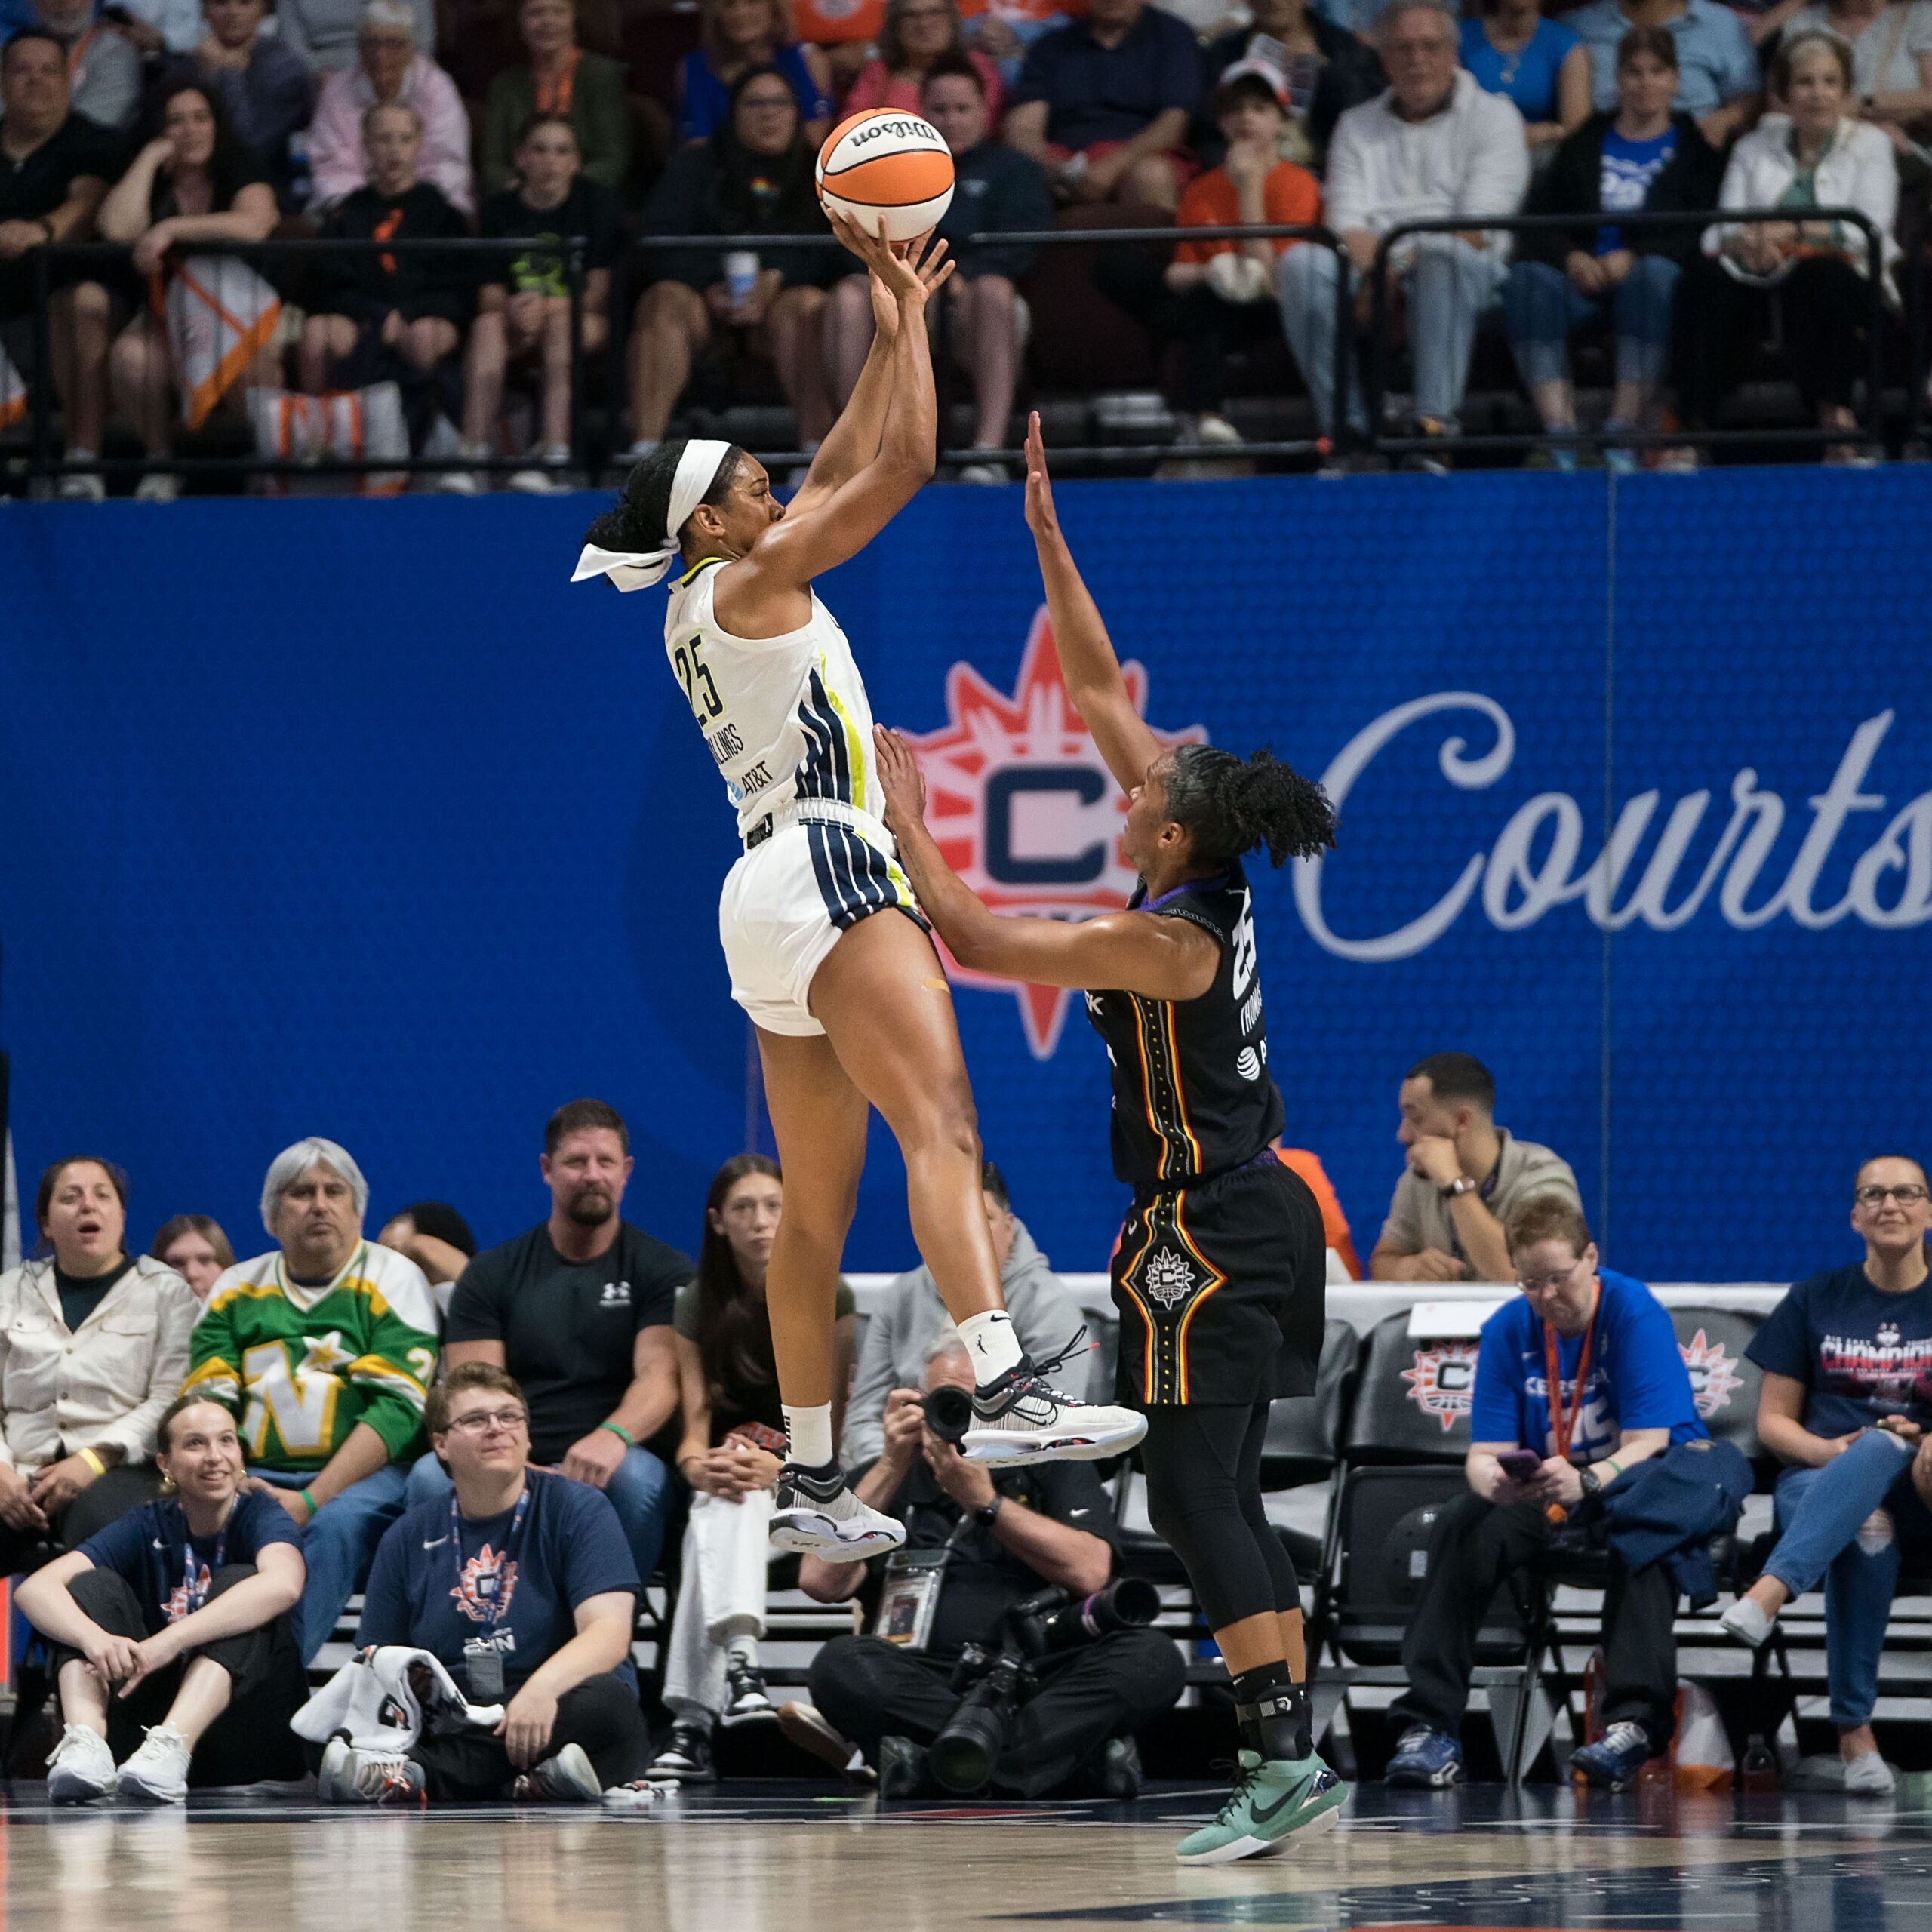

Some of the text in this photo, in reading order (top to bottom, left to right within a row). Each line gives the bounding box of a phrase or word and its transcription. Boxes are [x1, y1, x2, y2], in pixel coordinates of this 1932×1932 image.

[849, 121, 939, 147] Wilson
[675, 633, 724, 728] 25
[741, 759, 773, 798] AT&T
[986, 764, 1107, 885] C
